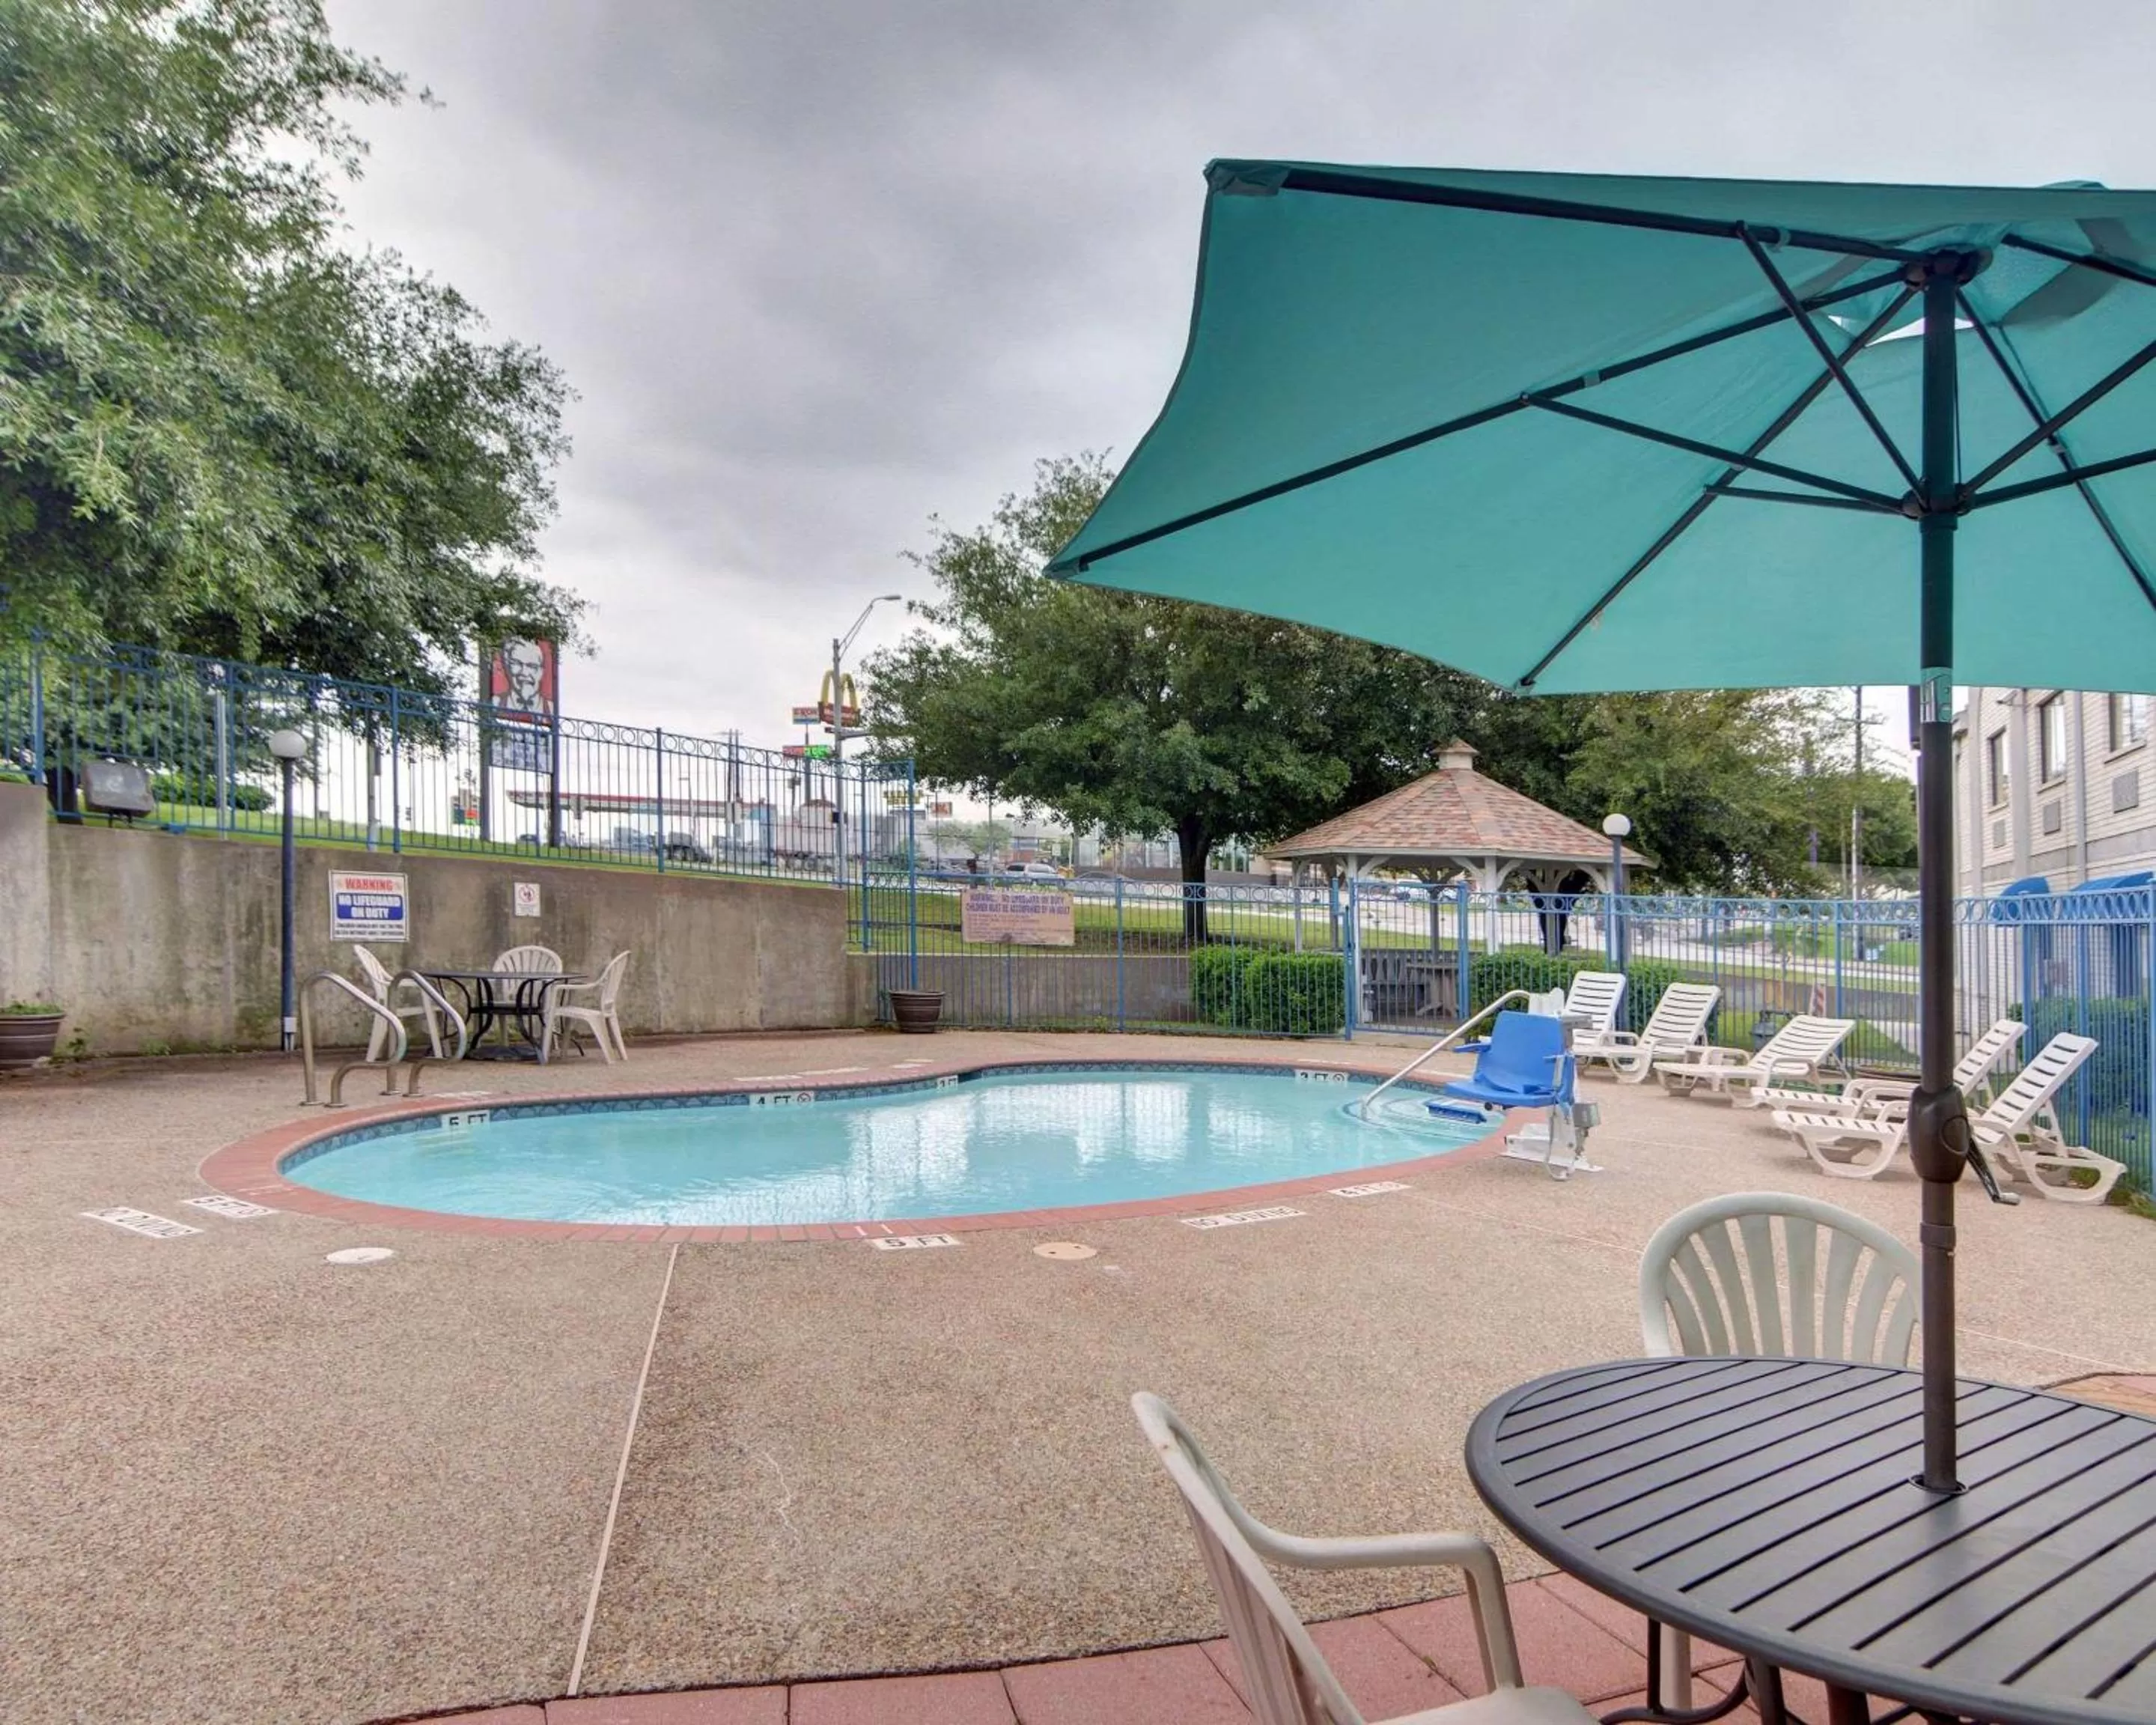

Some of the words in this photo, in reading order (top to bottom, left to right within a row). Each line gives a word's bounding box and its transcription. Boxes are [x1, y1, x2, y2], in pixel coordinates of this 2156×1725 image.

[345, 877, 394, 891] WARNING
[338, 894, 352, 905] NO
[353, 895, 401, 907] LIFEGUARD
[350, 906, 364, 917] ON
[365, 907, 389, 919] DUTY
[884, 1238, 907, 1248] 5
[917, 1235, 950, 1246] FT
